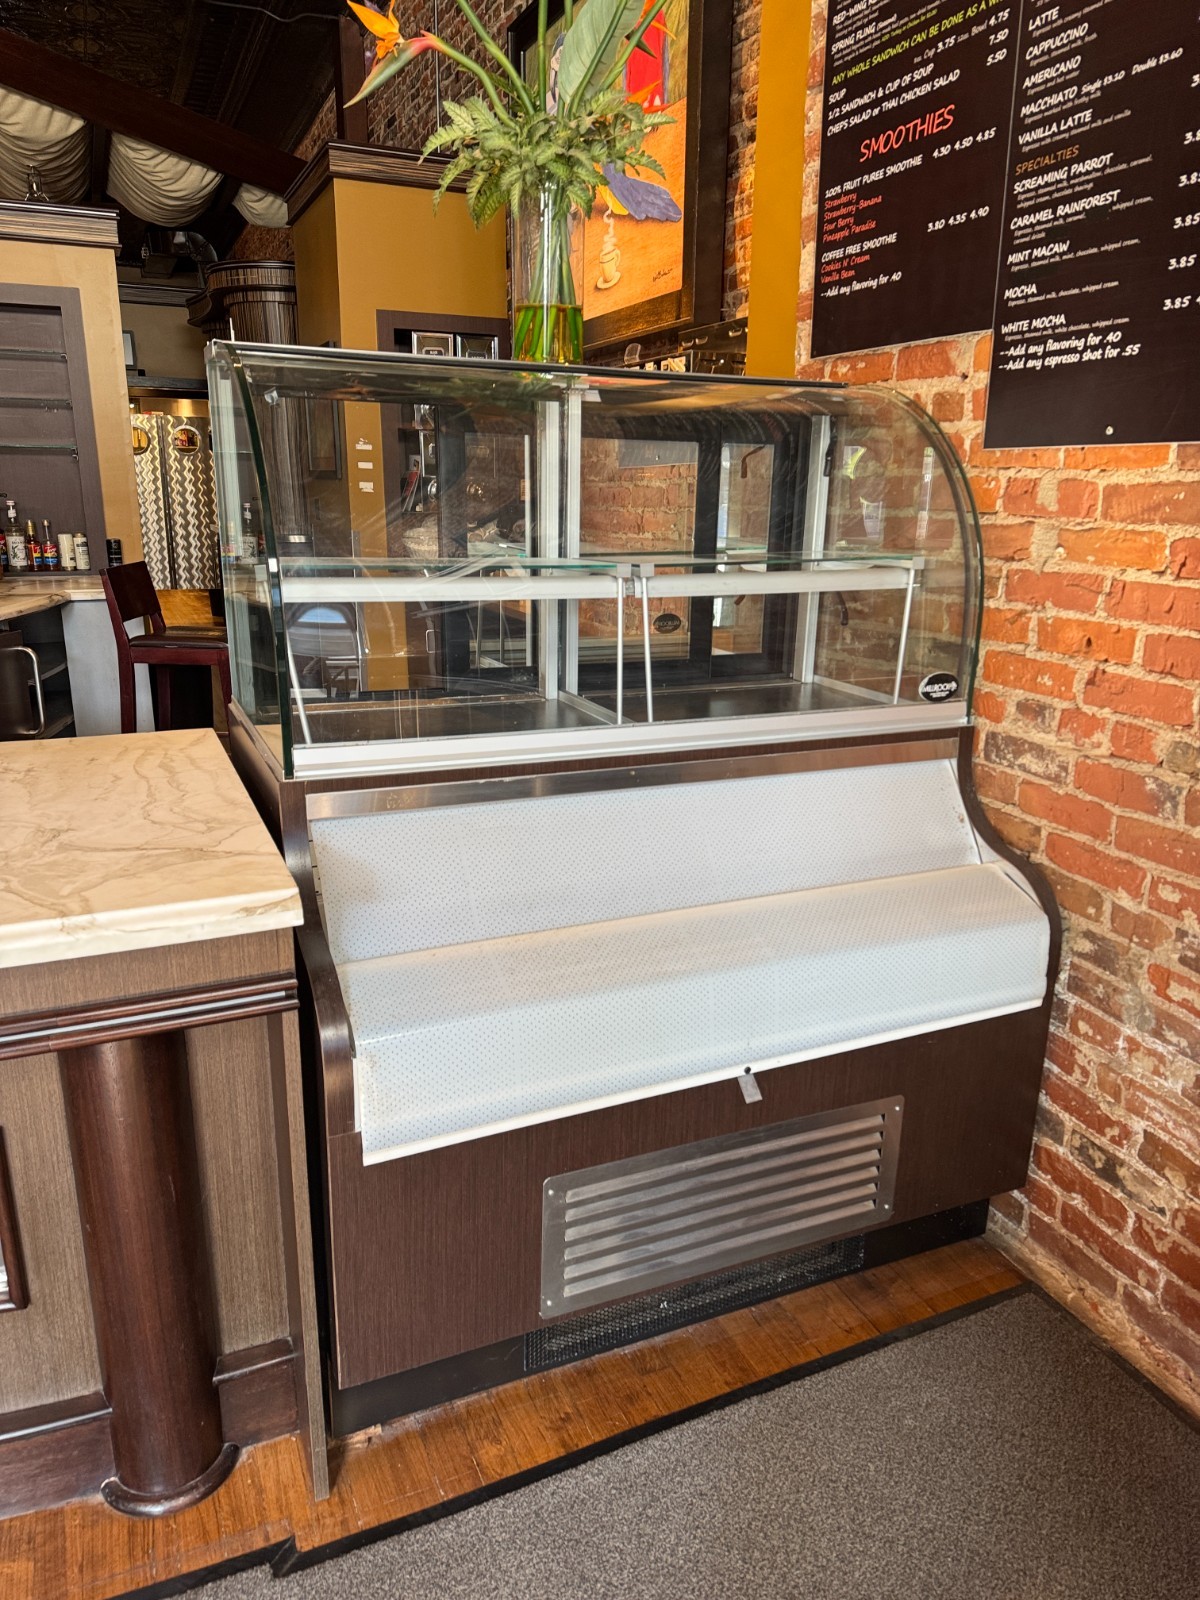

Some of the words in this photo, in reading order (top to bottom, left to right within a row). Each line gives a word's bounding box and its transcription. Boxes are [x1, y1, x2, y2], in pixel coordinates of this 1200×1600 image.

[1028, 6, 1060, 31] LATTE
[832, 34, 855, 54] SPRING
[856, 22, 876, 41] FLING
[832, 71, 846, 85] ANY
[847, 58, 871, 78] WHOLE
[872, 39, 909, 66] SANDWICH
[911, 30, 928, 46] CAN
[929, 23, 940, 38] BE
[941, 10, 964, 31] DONE
[966, 3, 978, 18] AS
[979, 0, 986, 12] A
[924, 48, 935, 58] Cup
[937, 35, 956, 52] 3.75
[971, 20, 988, 36] Bowl
[989, 8, 1010, 26] 4.75
[989, 28, 1009, 45] 7.50
[1025, 22, 1088, 60] CAPPUCCINO
[986, 48, 1007, 66] 5.50
[1132, 58, 1157, 75] Double
[1022, 55, 1081, 89] AMERICANO
[828, 108, 840, 120] 1/2
[841, 90, 876, 114] SANDWICH
[877, 87, 884, 98] &
[885, 79, 901, 94] CUP
[901, 73, 912, 87] OF
[912, 63, 934, 82] SOUP
[829, 88, 846, 105] SOUP
[849, 109, 872, 127] SALAD
[872, 106, 881, 116] or
[882, 97, 898, 112] THAI
[900, 82, 932, 105] CHICKEN
[933, 69, 960, 90] SALAD
[1020, 86, 1078, 117] MACCHIATO
[860, 104, 955, 162] SMOOTHIES
[1018, 122, 1058, 145] VANILLA
[1060, 109, 1093, 131] LATTE
[933, 144, 951, 158] 4.30
[954, 136, 973, 150] 4.50
[976, 127, 996, 142] 4.85
[1016, 144, 1079, 176] SPECIALTIES
[825, 185, 842, 198] 100%
[843, 177, 862, 192] FRUIT
[862, 168, 884, 185] PUREE
[886, 154, 923, 177] SMOOTHIE
[1013, 166, 1068, 194] SCREAMING
[1070, 152, 1114, 176] PARROT
[824, 193, 857, 210] Strawberry
[824, 195, 882, 221] Strawberry-Banana
[1010, 208, 1054, 230] CARAMEL
[1056, 189, 1121, 217] RAINFOREST
[823, 222, 837, 232] Four
[837, 217, 854, 228] Berry
[823, 228, 849, 242] Pineapple
[851, 221, 876, 234] Paradise
[927, 219, 945, 232] 3.80
[948, 212, 967, 225] 4.35
[970, 206, 990, 219] 4.90
[821, 248, 844, 263] COFFEE
[845, 243, 862, 256] FREE
[862, 232, 897, 251] SMOOTHIE
[1007, 249, 1032, 265] MINT
[1032, 240, 1070, 259] MACAW
[821, 262, 841, 273] Cookies
[850, 255, 870, 266] Cream
[1168, 254, 1197, 270] 3.85
[821, 272, 840, 283] Vanilla
[840, 270, 855, 279] Bean
[839, 286, 851, 295] any
[851, 278, 878, 291] flavoring
[879, 274, 889, 285] for
[1004, 283, 1037, 299] MOCHA
[1163, 296, 1191, 310] 3.85
[1001, 320, 1030, 334] WHITE
[1031, 314, 1066, 329] MOCHA
[1027, 344, 1044, 356] any
[1046, 338, 1085, 352] flavoring
[1086, 333, 1102, 346] for
[1026, 359, 1043, 370] any
[1044, 353, 1080, 368] espresso
[1081, 348, 1103, 361] shot
[1104, 347, 1120, 359] for
